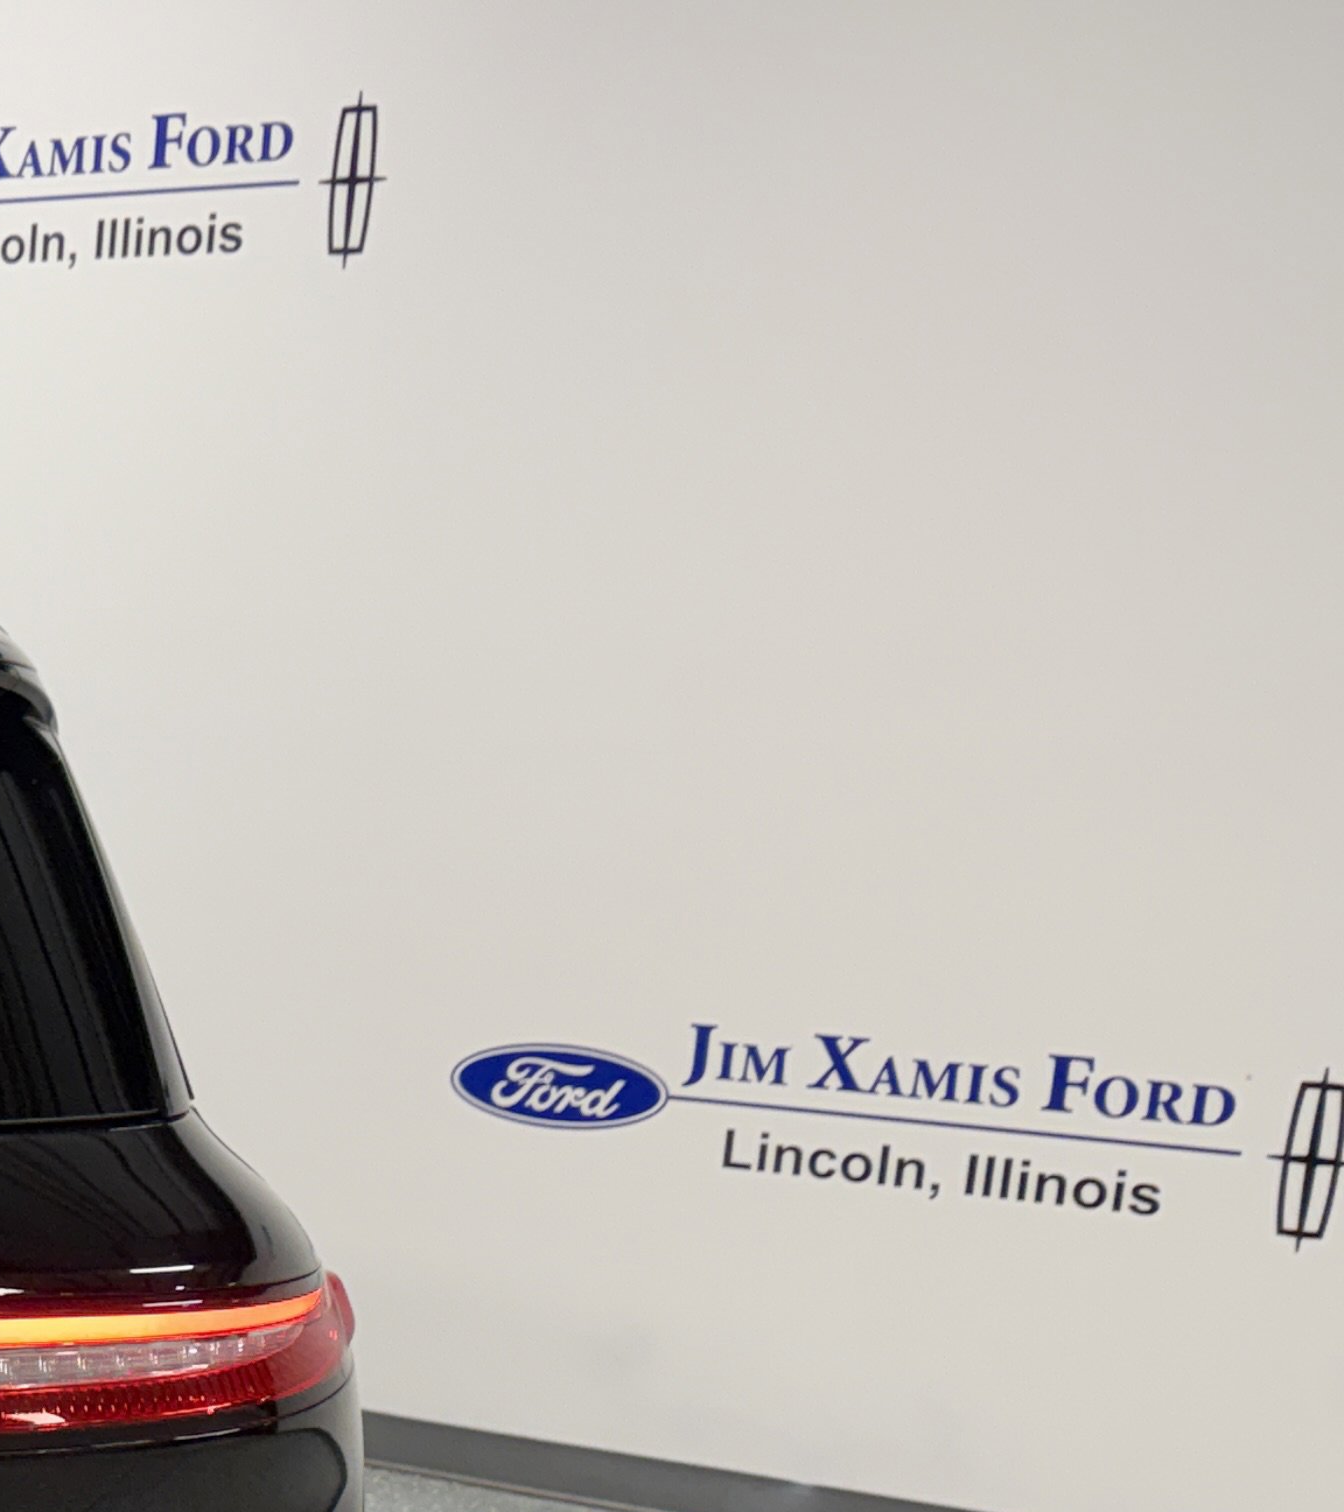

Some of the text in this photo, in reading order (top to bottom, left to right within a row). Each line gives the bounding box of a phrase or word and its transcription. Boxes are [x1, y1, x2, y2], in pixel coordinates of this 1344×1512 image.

[147, 112, 294, 170] FORD
[94, 212, 244, 260] Illinois
[490, 1056, 626, 1118] Ford
[681, 1023, 1236, 1127] JIM XAMIS FORD
[722, 1128, 1161, 1216] Lincoln, Illinois
